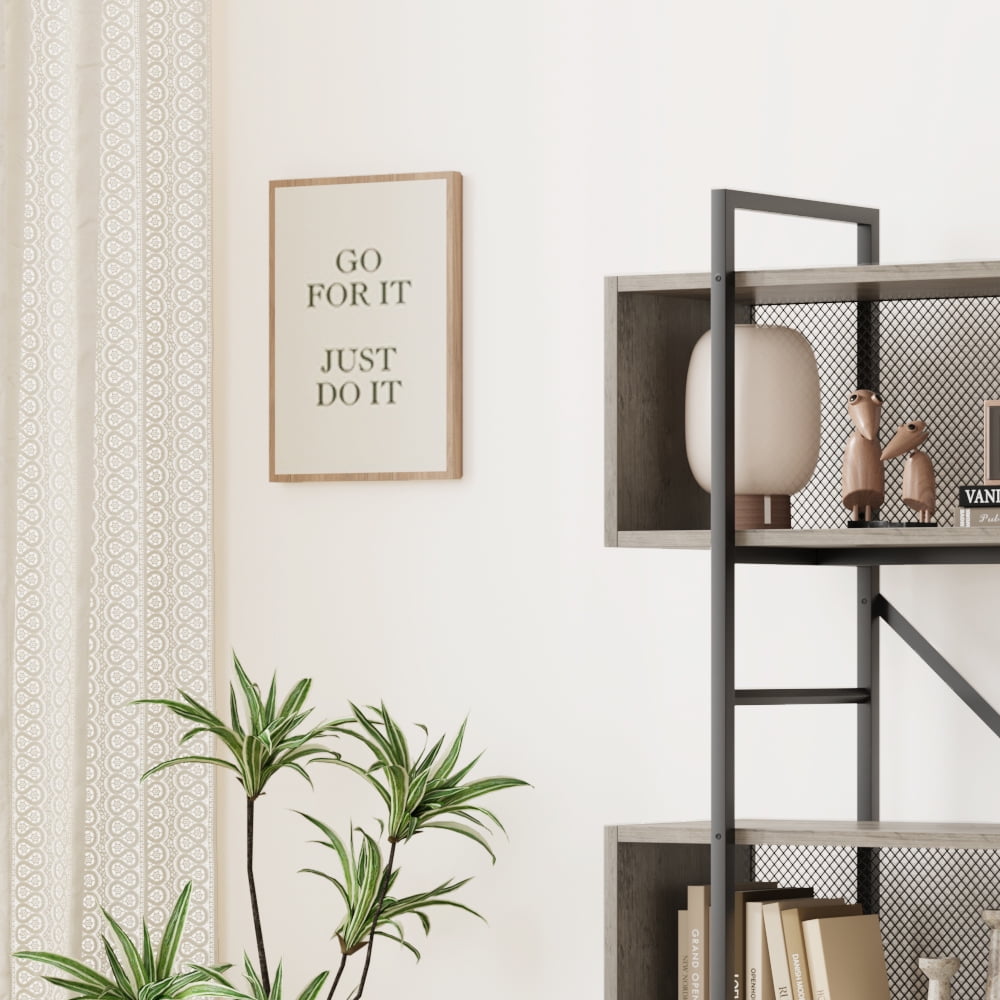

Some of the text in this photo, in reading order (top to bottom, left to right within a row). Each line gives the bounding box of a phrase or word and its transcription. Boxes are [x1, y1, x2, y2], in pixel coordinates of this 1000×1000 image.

[336, 248, 382, 274] GO
[307, 280, 412, 308] FOR IT
[320, 347, 397, 374] JUST
[316, 380, 403, 407] DO IT
[691, 928, 700, 969] GRAND
